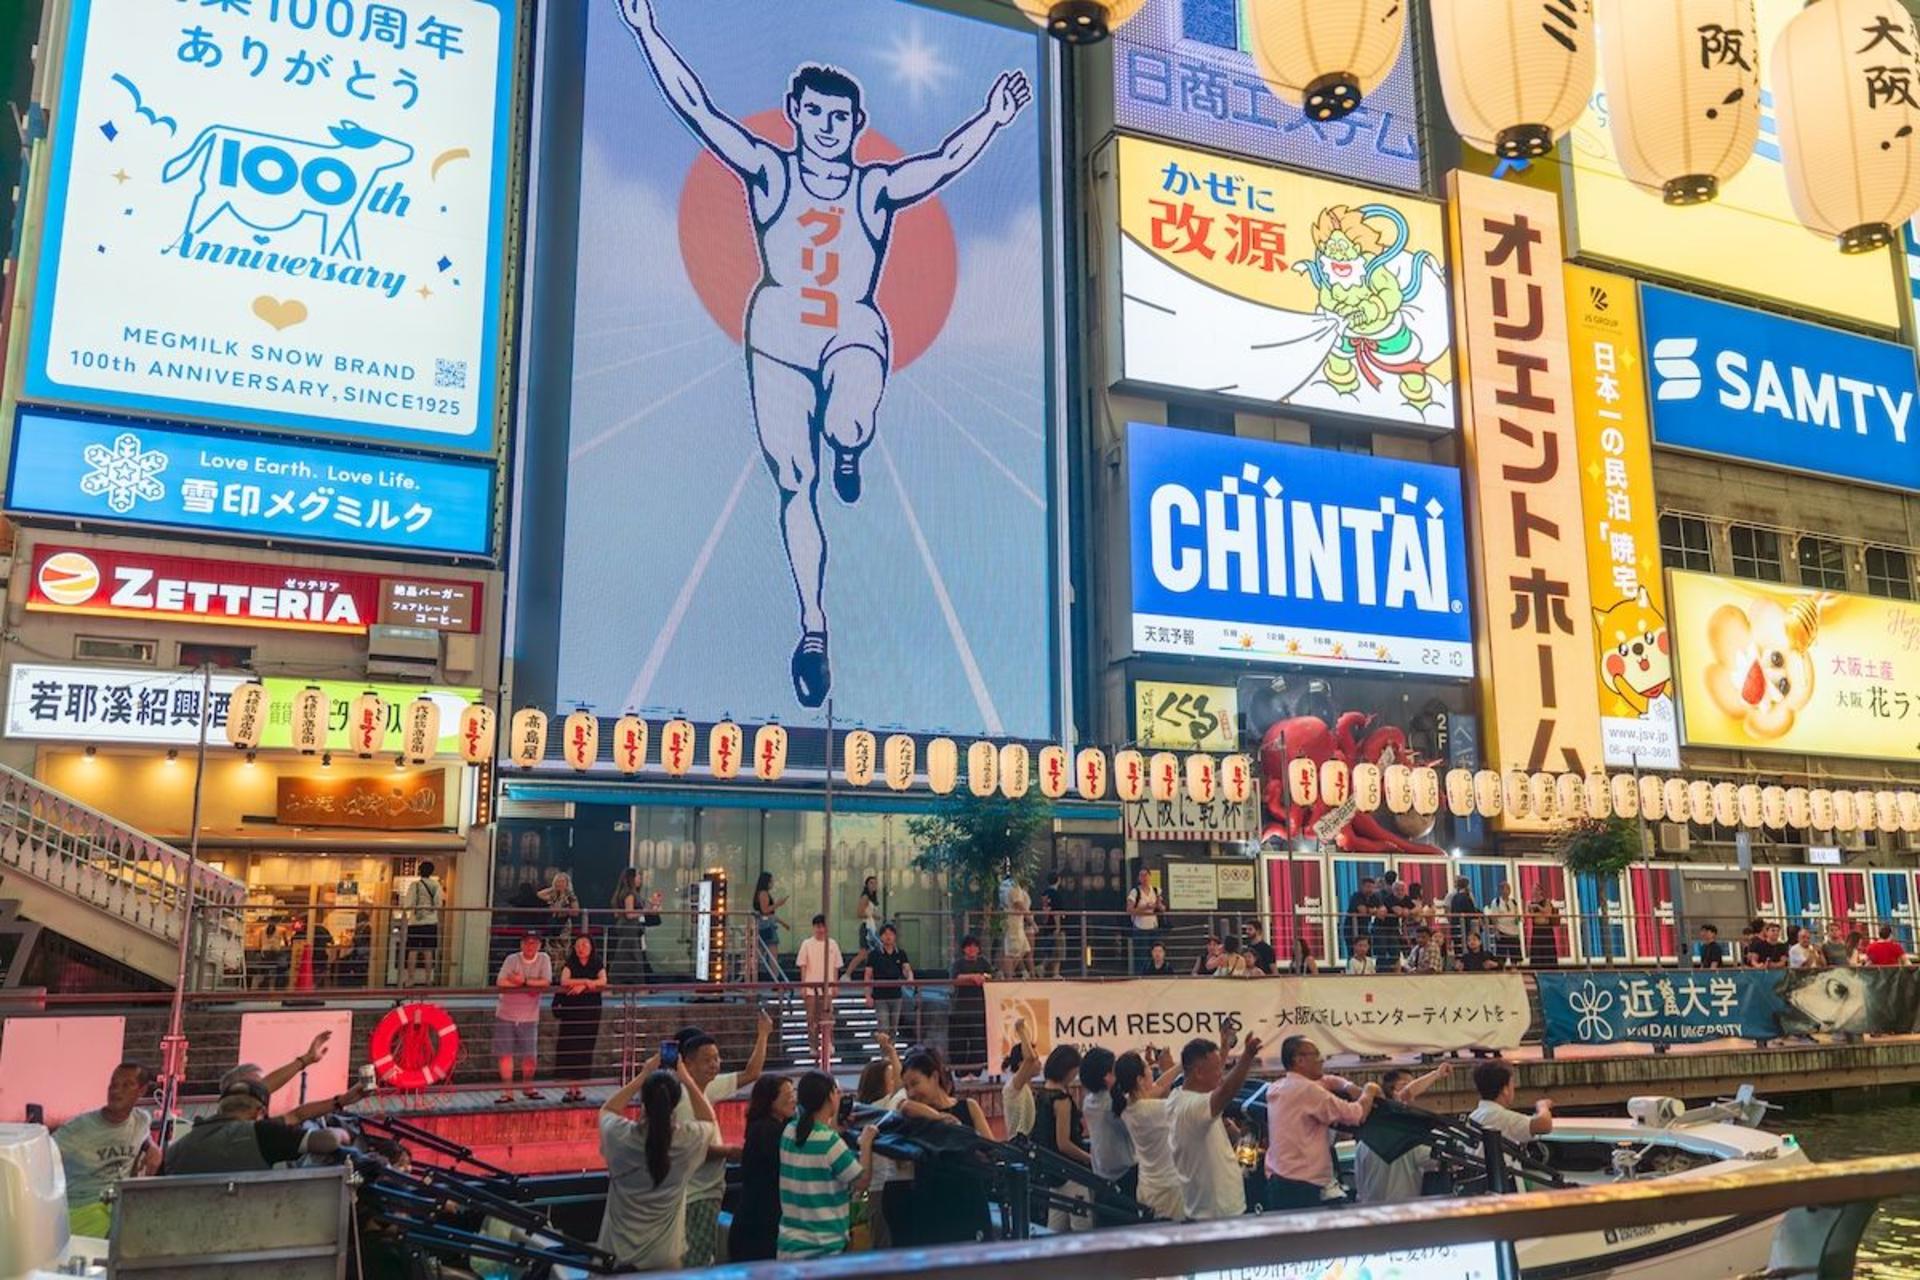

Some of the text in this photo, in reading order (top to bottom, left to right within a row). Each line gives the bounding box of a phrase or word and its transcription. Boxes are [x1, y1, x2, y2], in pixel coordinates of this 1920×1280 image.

[178, 0, 463, 60] 100周年
[177, 25, 419, 110] ありがとう
[219, 139, 410, 217] 100 th
[1161, 163, 1275, 213] かぜに
[1148, 199, 1290, 273] 改源
[161, 231, 406, 298] Anniversary
[797, 207, 845, 329] グリコ
[70, 351, 136, 373] 100th
[123, 326, 416, 381] MEGMILK SNOW BRAND
[1716, 350, 1912, 443] SAMTY
[201, 451, 421, 490] Love Earth. Love Life.
[1483, 214, 1584, 776] オリエントホーム
[181, 479, 433, 533] 雪印メグミルク
[110, 566, 360, 624] ZETTERIA
[284, 578, 340, 593] ゼッテリア
[394, 584, 464, 599] 絶品バーガー
[416, 613, 462, 625] コーヒー
[1144, 626, 1194, 646] 天気予報
[1831, 656, 1894, 681] 大阪土産
[1156, 692, 1218, 740] くくる
[1867, 686, 1920, 719] 花ラ
[521, 714, 541, 760] 高島屋
[1055, 1011, 1243, 1038] MGM RESORTS
